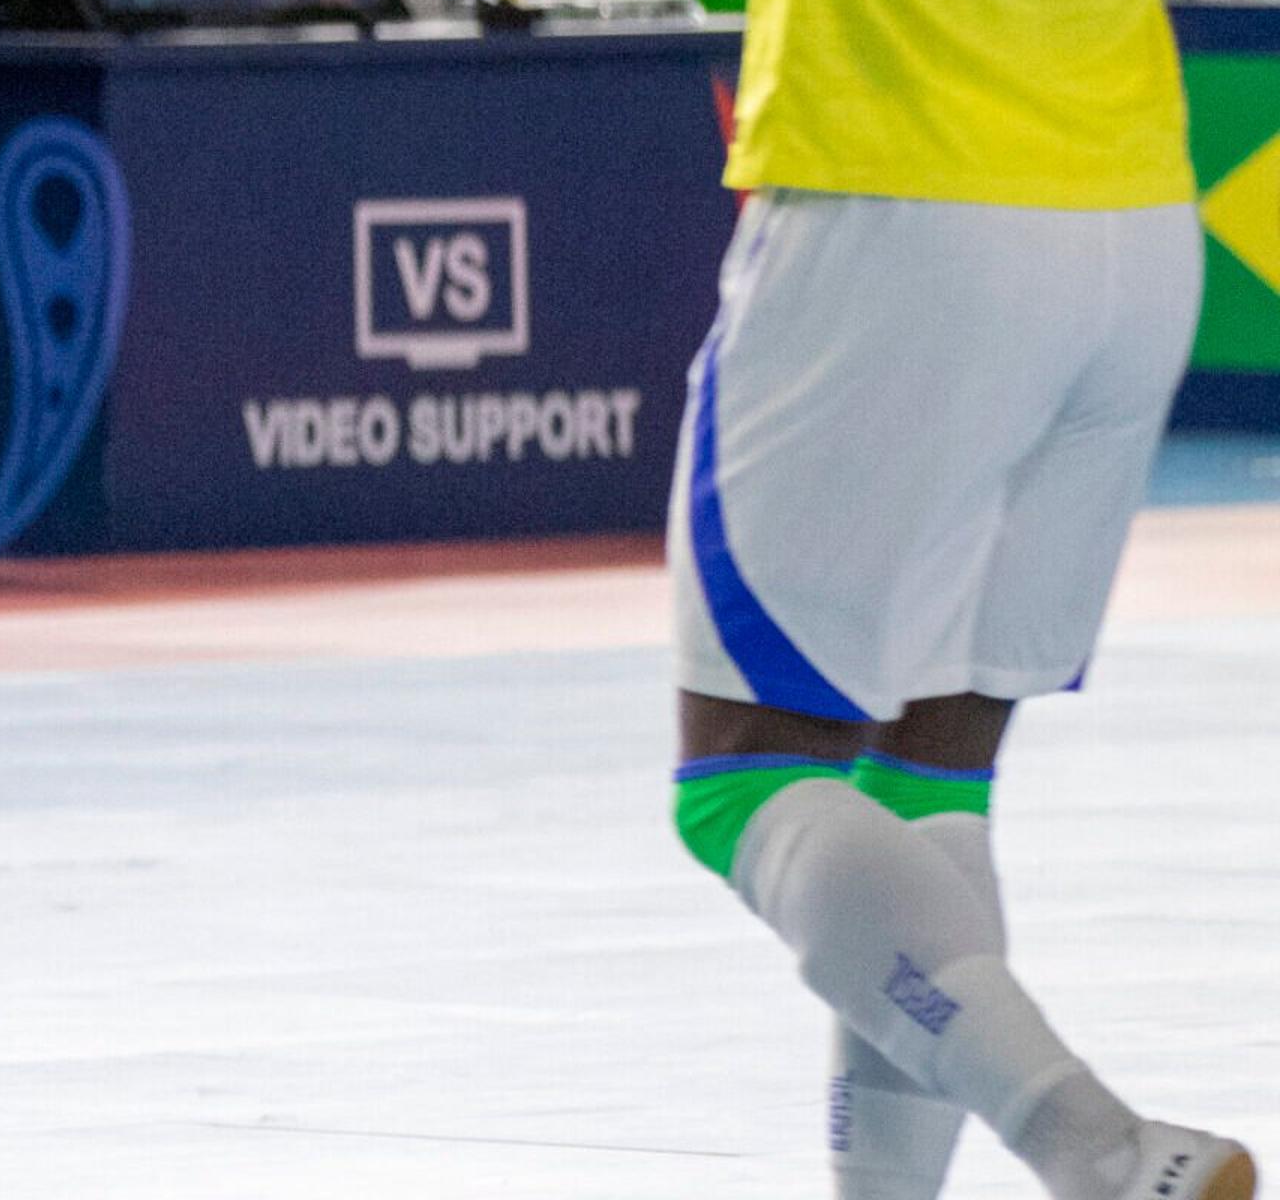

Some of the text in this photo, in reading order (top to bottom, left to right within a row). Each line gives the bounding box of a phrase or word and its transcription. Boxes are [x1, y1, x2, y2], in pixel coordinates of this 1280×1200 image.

[393, 232, 492, 324] VS
[243, 388, 639, 469] VIDEO SUPPORT
